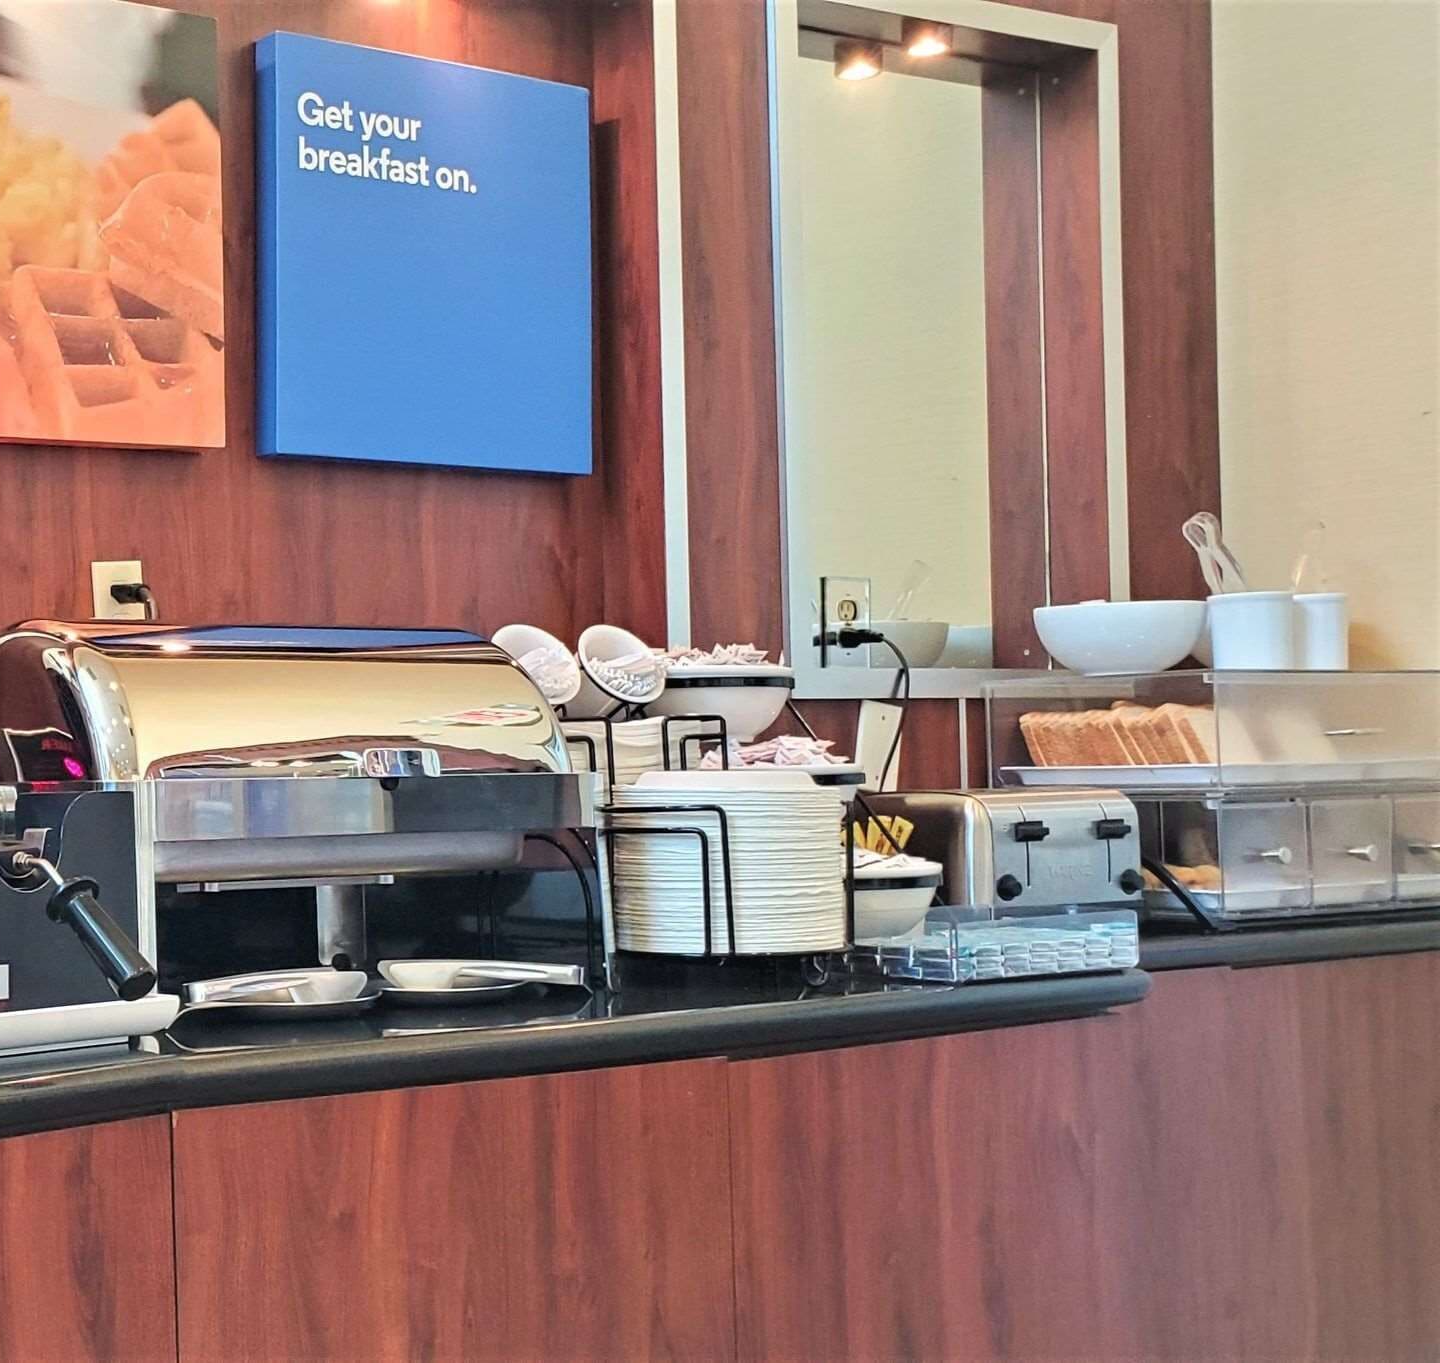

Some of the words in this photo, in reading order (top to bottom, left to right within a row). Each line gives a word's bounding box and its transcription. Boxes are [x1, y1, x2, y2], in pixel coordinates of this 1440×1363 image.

[297, 91, 354, 132] Get
[359, 111, 422, 141] your
[298, 136, 431, 187] breakfast
[435, 167, 478, 194] on.
